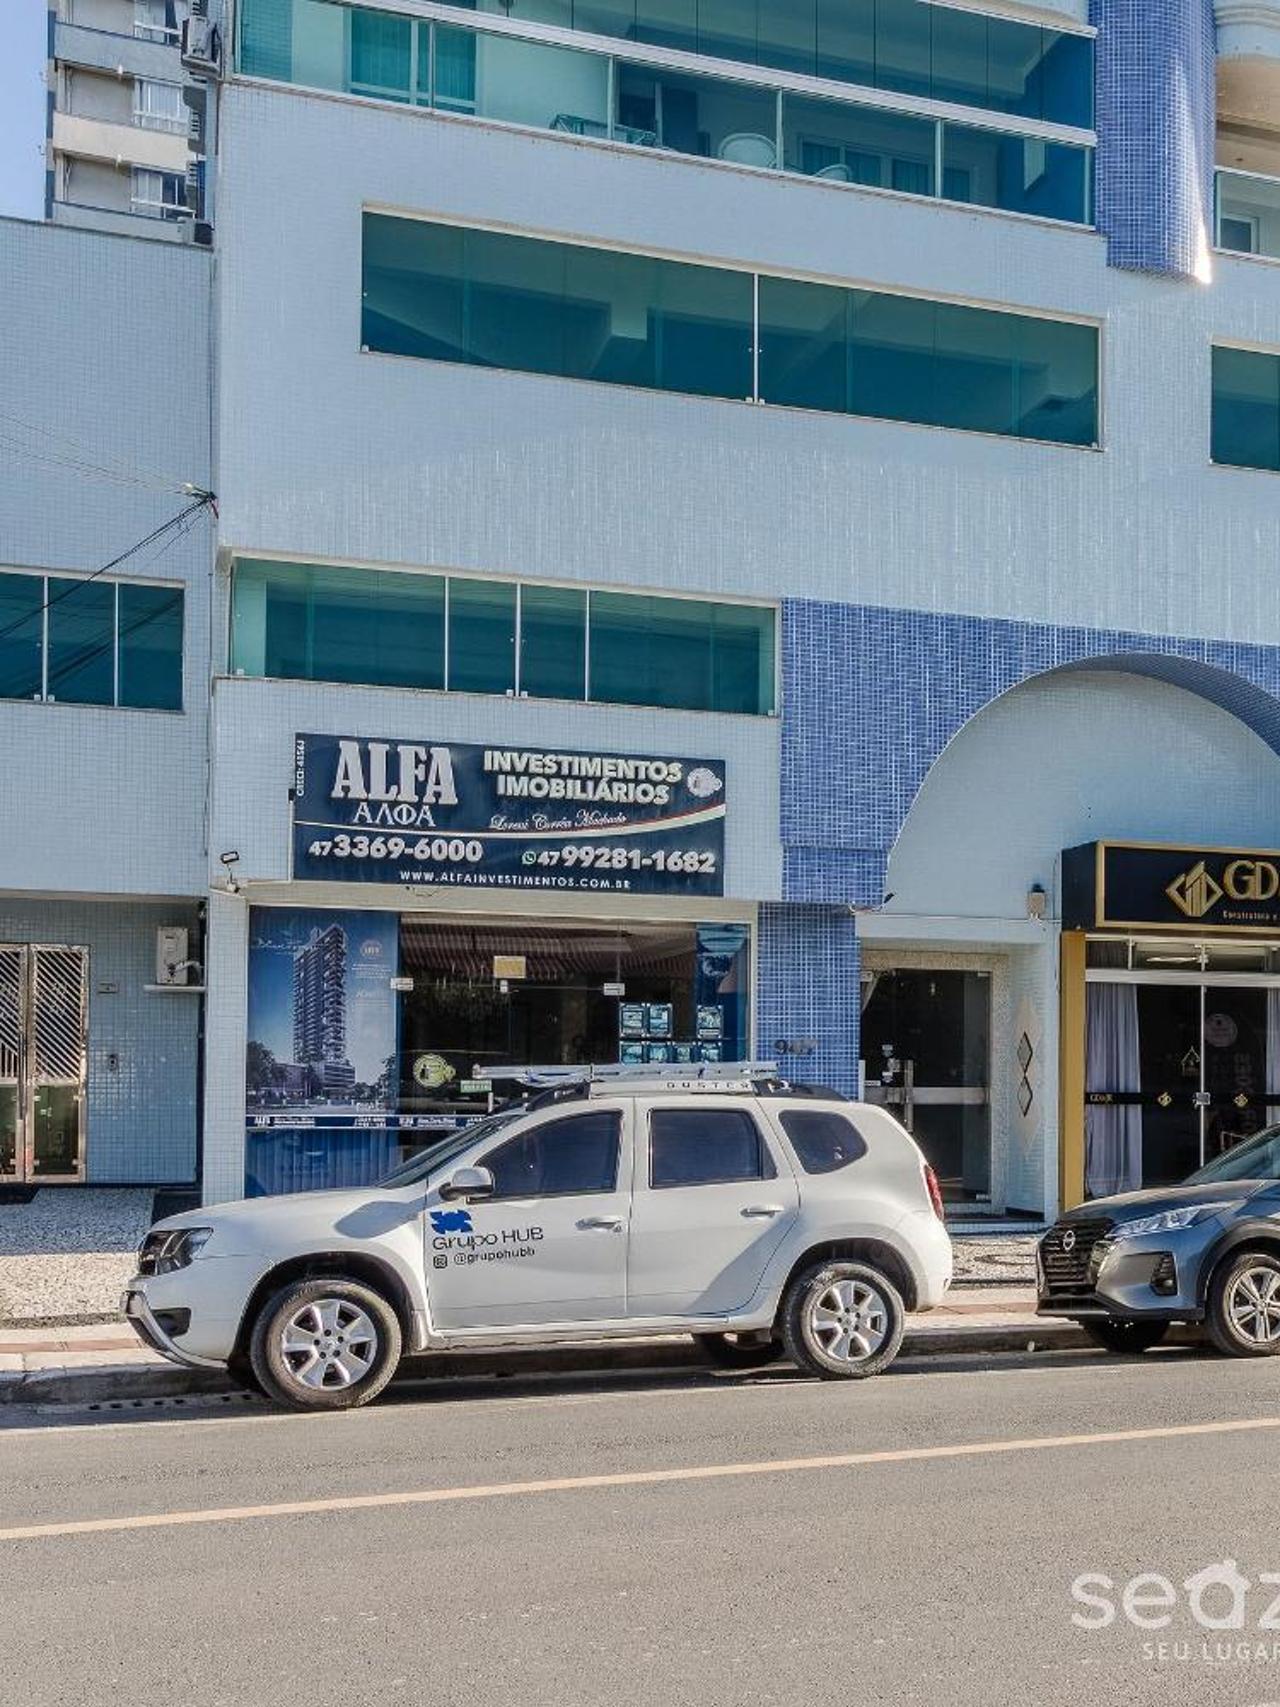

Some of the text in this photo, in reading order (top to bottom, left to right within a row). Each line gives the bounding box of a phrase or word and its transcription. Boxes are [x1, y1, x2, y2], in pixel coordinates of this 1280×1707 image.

[331, 740, 458, 806] ALFA
[483, 750, 682, 783] INVESTIMENTOS
[496, 774, 670, 805] IMOBILIÁRIOS
[308, 834, 484, 862] 47 3369-6000
[537, 845, 716, 874] 47 99281-1682
[399, 870, 632, 890] WWW.ALFAINVESTIMENTOS.COM.BR
[432, 1227, 544, 1250] Grupo HUB
[454, 1247, 536, 1265] @grupohubb
